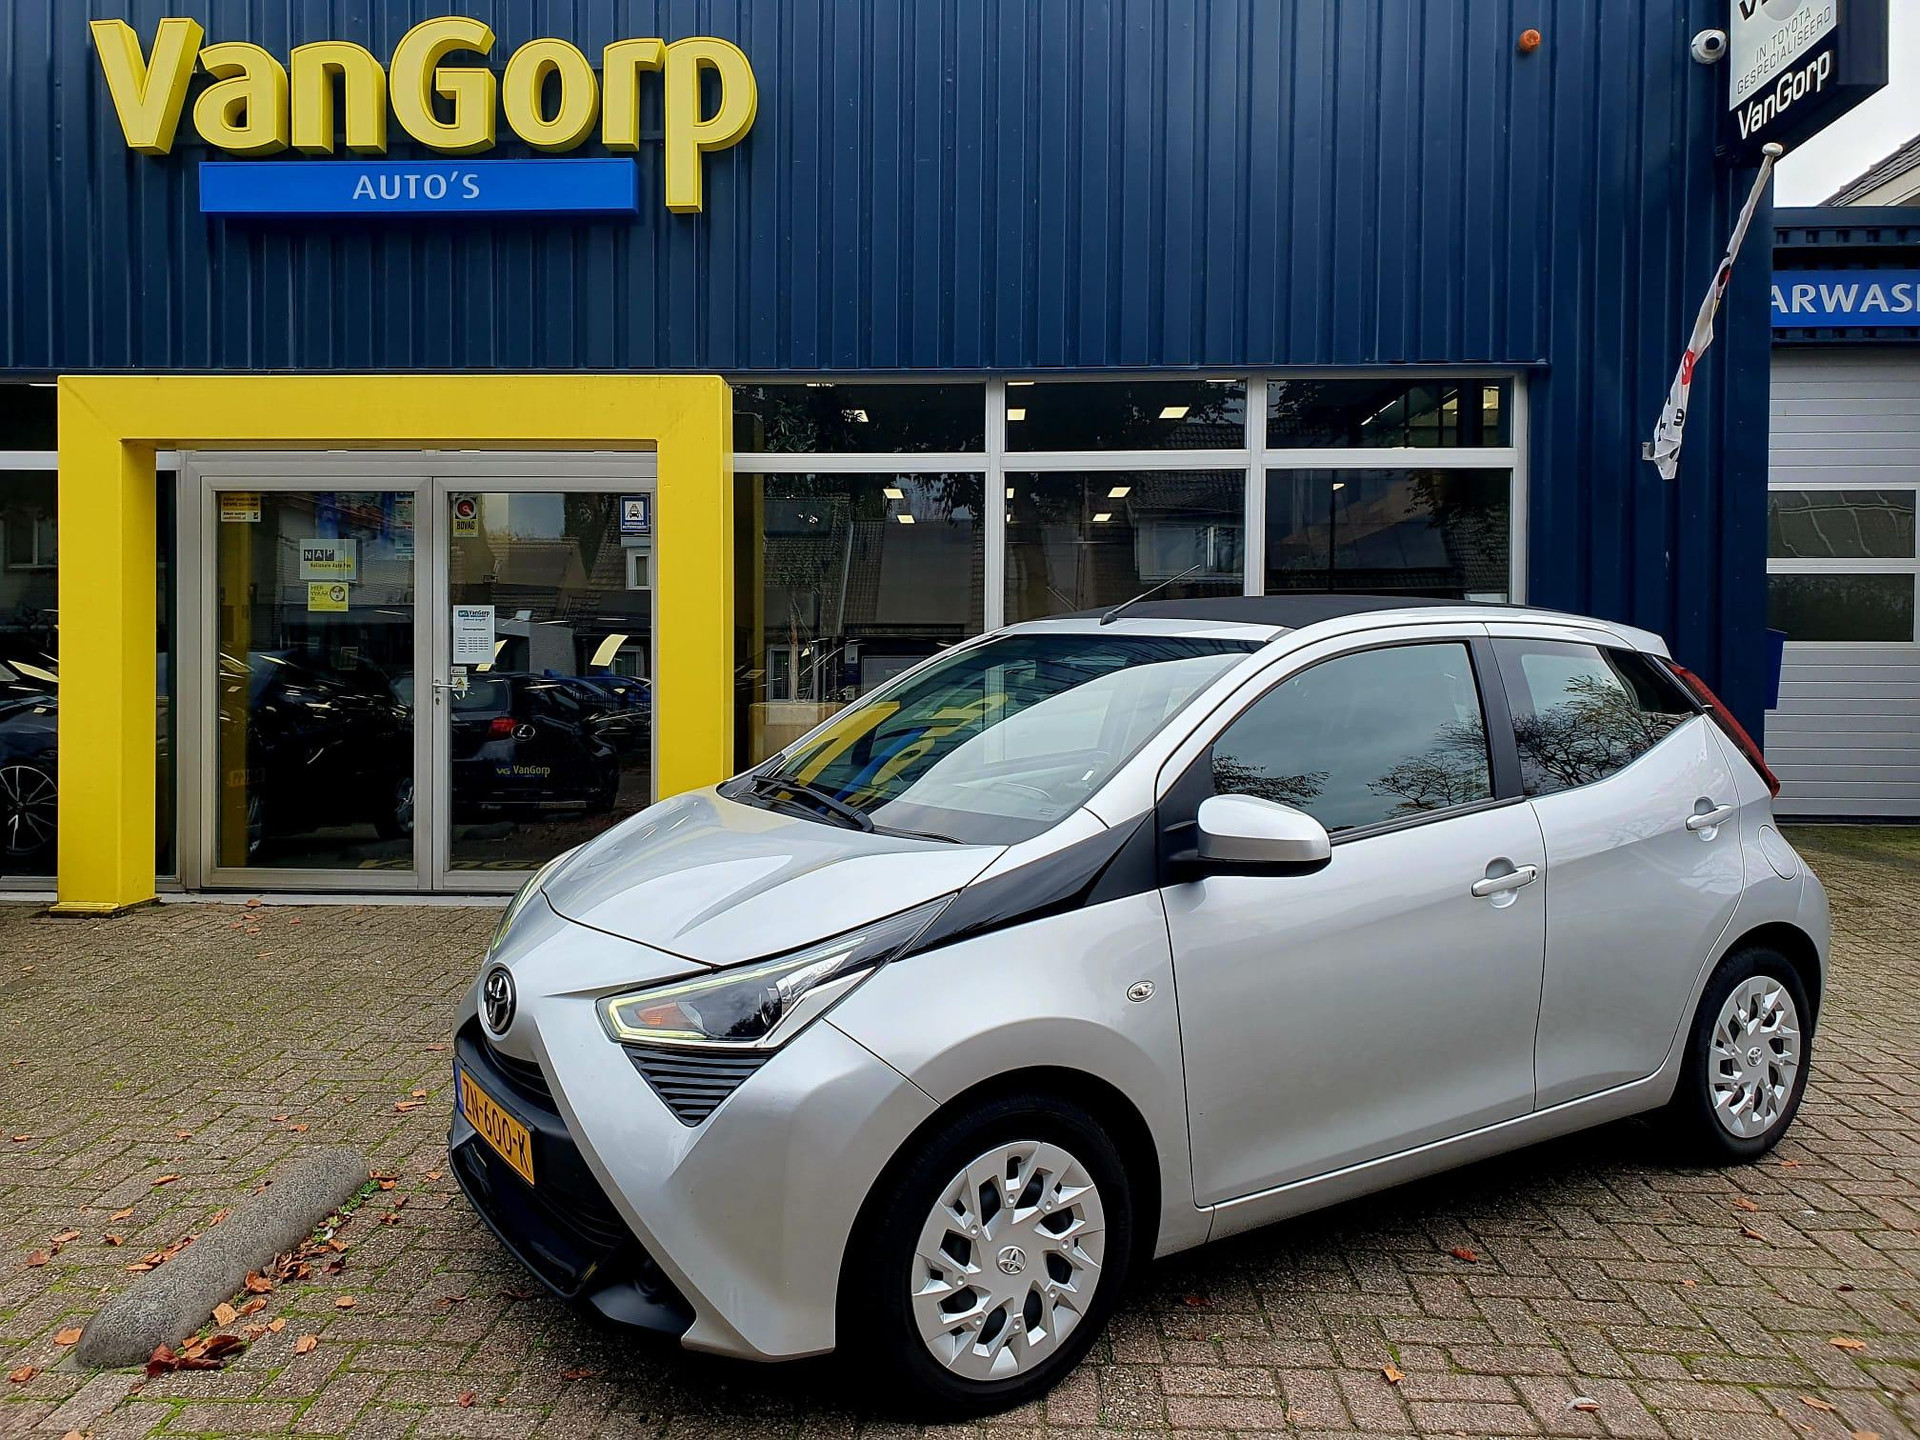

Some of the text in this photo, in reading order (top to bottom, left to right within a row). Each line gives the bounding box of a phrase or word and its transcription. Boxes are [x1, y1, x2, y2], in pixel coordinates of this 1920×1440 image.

[1737, 5, 1831, 95] GESPECIALISEERD
[1755, 43, 1767, 64] IN
[1771, 6, 1811, 49] TOYOTA
[89, 15, 758, 213] VanGorp
[1737, 50, 1831, 140] VanGorp
[352, 170, 480, 200] AUTO'S
[1770, 283, 1920, 313] ARWAS
[513, 765, 551, 778] VanGorp
[463, 1078, 530, 1174] ZN-600-K
